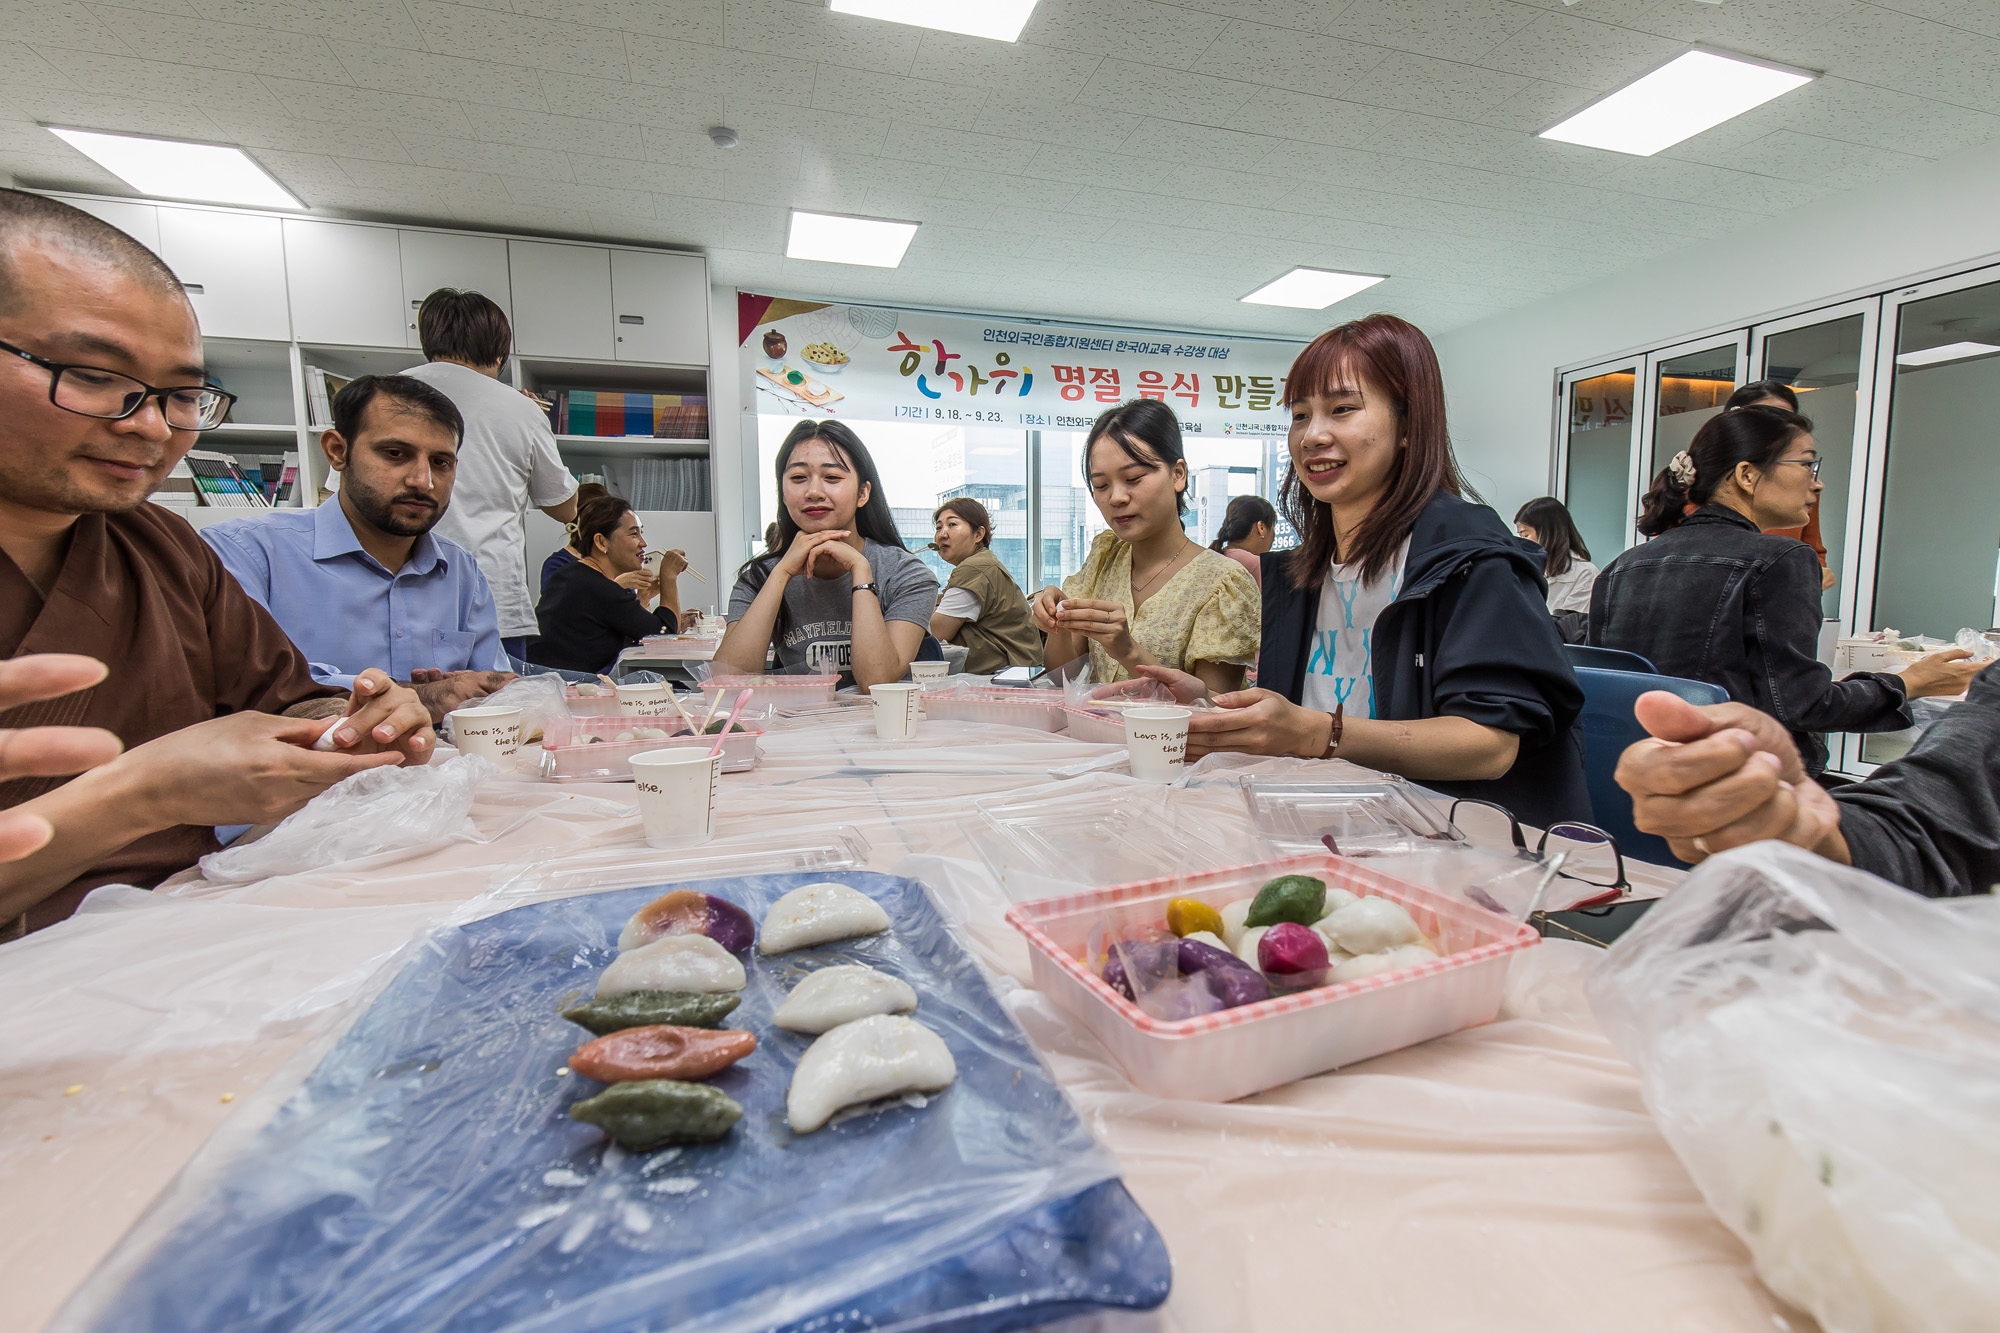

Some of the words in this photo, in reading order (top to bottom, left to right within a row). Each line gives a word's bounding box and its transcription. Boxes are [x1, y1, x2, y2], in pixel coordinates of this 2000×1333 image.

[983, 328, 1113, 352] 인천외국인종합지원센터
[1116, 340, 1171, 356] 한국어교육
[1173, 344, 1206, 358] 수강생
[1207, 347, 1230, 360] 대상
[887, 331, 1033, 399] 한가위
[1051, 364, 1121, 403] 명절
[1136, 370, 1200, 408] 음식
[901, 405, 923, 418] 기간
[1025, 413, 1046, 426] 장소
[1056, 415, 1097, 427] 인천외국
[492, 727, 504, 735] is,
[1134, 731, 1157, 740] Love
[1161, 733, 1172, 741] is,
[494, 738, 510, 746] the
[1162, 745, 1178, 753] the
[637, 782, 662, 794] else,
